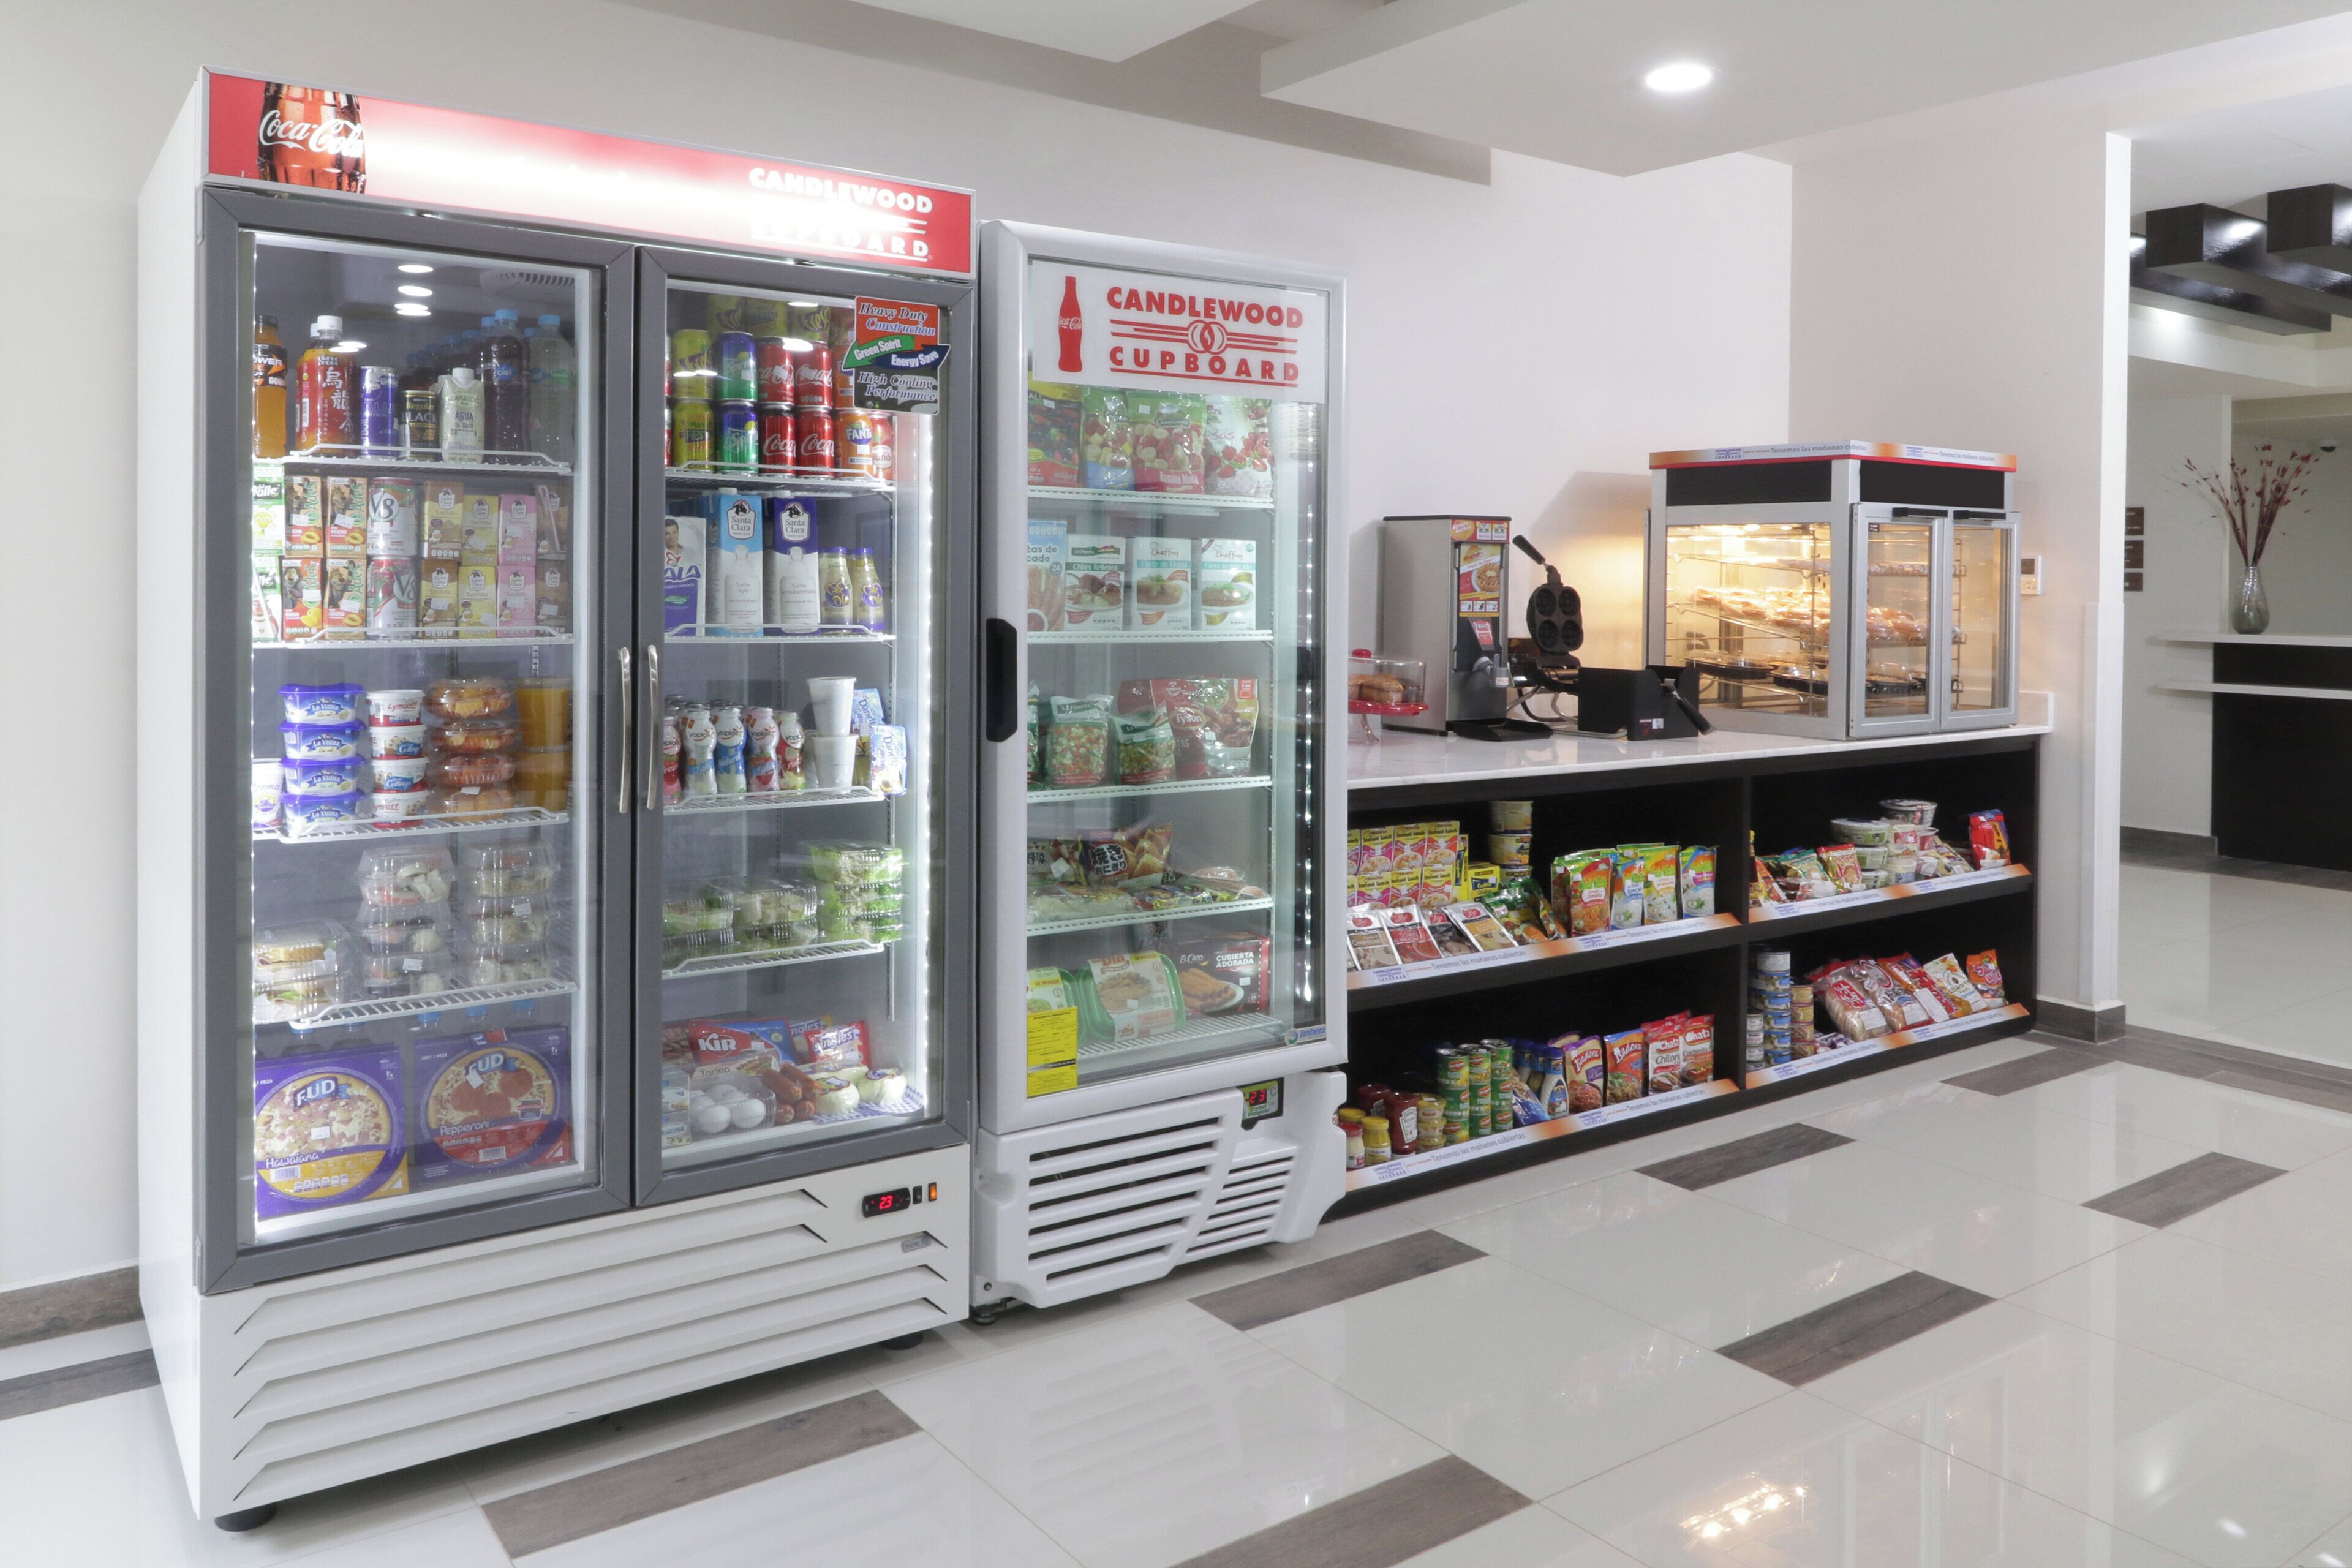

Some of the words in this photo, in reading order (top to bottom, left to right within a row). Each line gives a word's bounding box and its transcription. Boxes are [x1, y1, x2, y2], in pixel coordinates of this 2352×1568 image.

[258, 109, 365, 159] Coca-Cola
[749, 167, 933, 214] CANDLEWOOD
[859, 302, 897, 320] Heavy
[899, 307, 928, 323] Duty
[1107, 287, 1303, 328] CANDLEWOOD
[866, 318, 936, 336] Construction
[853, 345, 880, 360] Green
[878, 339, 902, 354] Spirit
[891, 354, 919, 368] Energy
[918, 350, 939, 365] Save
[1109, 346, 1299, 381] CUPBOARD
[858, 371, 888, 386] High
[889, 374, 933, 390] Cooling
[865, 384, 936, 401] Performance
[406, 401, 434, 410] Regular
[455, 410, 474, 421] AGUA
[371, 490, 394, 519] V8
[731, 516, 752, 524] Santa
[393, 571, 416, 600] V8
[1175, 714, 1204, 727] Tyson
[1216, 952, 1254, 962] CUBIERTA
[1216, 958, 1254, 968] ADOBADA
[1431, 959, 1460, 970] Tenemos
[1471, 955, 1498, 964] mañanas
[1498, 950, 1526, 959] cubiertas
[296, 1079, 336, 1106] FUD
[1250, 1089, 1266, 1103] 23
[440, 1121, 489, 1136] Pepperoni
[1431, 1151, 1460, 1162] Tenemos
[1471, 1141, 1498, 1152] mañanas
[1498, 1133, 1526, 1145] cubiertas
[265, 1152, 320, 1169] Hawaiana
[878, 1194, 894, 1210] 23
